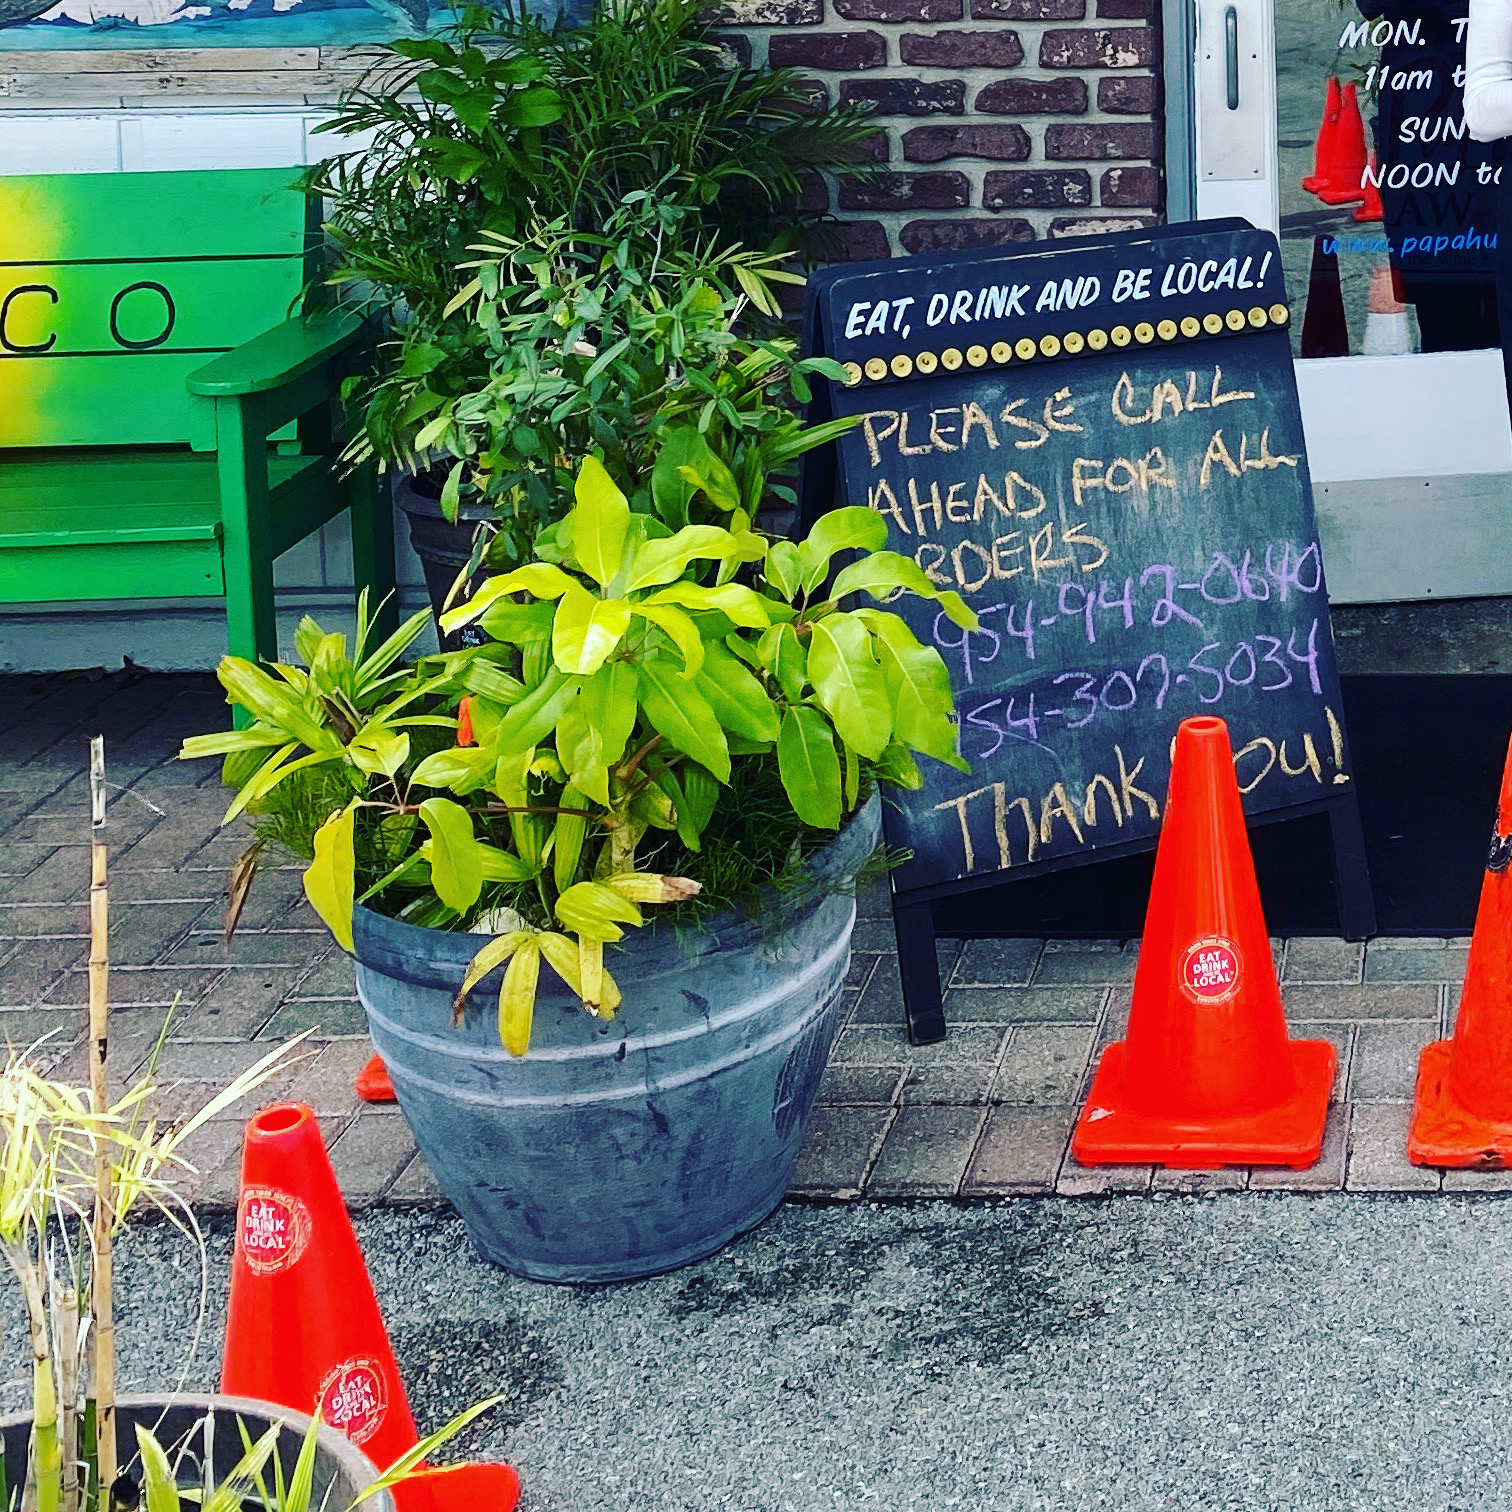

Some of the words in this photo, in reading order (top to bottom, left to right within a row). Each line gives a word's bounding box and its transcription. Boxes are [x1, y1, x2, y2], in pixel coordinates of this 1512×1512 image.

[1338, 18, 1427, 48] MON.
[1364, 65, 1433, 91] 11am
[1360, 160, 1460, 189] NOON
[844, 297, 915, 341] EAT,
[926, 283, 1030, 328] DRINK
[1036, 276, 1101, 315] AND
[1112, 268, 1154, 303] BE
[1160, 250, 1274, 296] LOCAL!
[860, 387, 1085, 468] PLEASE
[1111, 364, 1256, 426] CALL
[867, 470, 1047, 536] AHEAD
[1072, 445, 1177, 508] FOR
[1200, 427, 1300, 489] ALL
[880, 521, 1109, 604] RDERS
[932, 541, 1321, 684] 954-942-0640
[954, 618, 1323, 762] 54-307-5034
[1169, 705, 1351, 796] ou!
[1192, 959, 1229, 974] DRINK
[1198, 950, 1221, 963] EAT
[1193, 972, 1232, 987] LOCAL
[245, 1216, 285, 1232] DRINK
[251, 1205, 276, 1220] EAT
[244, 1232, 286, 1249] LOCAL
